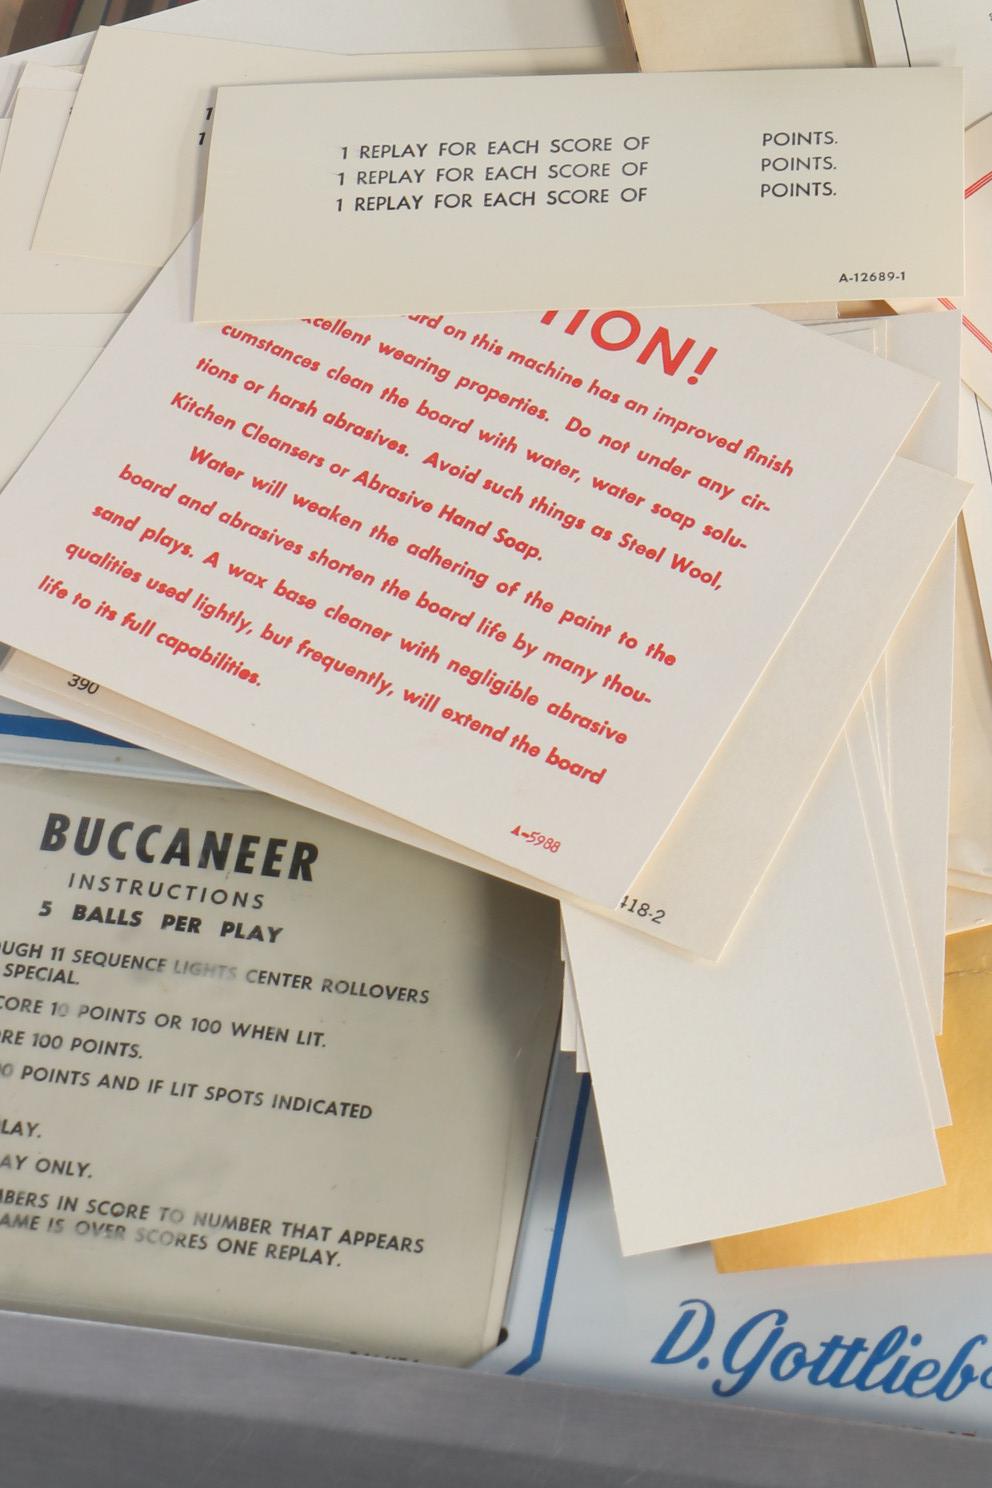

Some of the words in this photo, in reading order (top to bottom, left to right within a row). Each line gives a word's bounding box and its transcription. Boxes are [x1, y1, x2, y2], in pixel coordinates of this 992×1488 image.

[341, 146, 348, 160] 1
[359, 142, 428, 159] REPLAY
[438, 141, 477, 157] FOR
[487, 139, 539, 155] EACH
[549, 136, 612, 153] SCORE
[623, 135, 650, 151] OF
[762, 130, 838, 147] POINTS.
[838, 270, 905, 283] A-12689-1
[189, 445, 244, 480] Water
[250, 475, 288, 497] will
[291, 493, 363, 532] weaken
[369, 523, 399, 547] the
[405, 543, 490, 589] adhering
[495, 579, 521, 596] of
[523, 590, 555, 613] the
[557, 608, 612, 637] paint
[617, 631, 639, 650] to
[644, 641, 677, 667] the
[37, 574, 70, 600] life
[71, 591, 93, 609] to
[94, 599, 117, 622] its
[120, 610, 157, 638] full
[155, 632, 263, 686] capabilities.
[66, 674, 100, 695] 390
[39, 811, 321, 883] BUCCANEER
[511, 825, 560, 852] A-5988
[67, 871, 265, 910] INSTRUCTIONS
[37, 899, 53, 917] 5
[70, 903, 144, 928] BALLS
[159, 912, 202, 935] PER
[218, 919, 284, 944] PLAY
[1, 962, 80, 986] SPECIAL.
[49, 945, 66, 962] 11
[70, 948, 168, 973] SEQUENCE
[244, 968, 313, 991] CENTER
[320, 977, 430, 1005] ROLLOVERS
[19, 1064, 91, 1087] POINTS
[95, 1072, 140, 1092] AND
[146, 1078, 165, 1095] IF
[168, 1080, 199, 1099] LIT
[202, 1085, 265, 1107] SPOTS
[270, 1092, 373, 1120] INDICATED
[215, 1236, 259, 1257] ONE
[263, 1242, 341, 1268] REPLAY.
